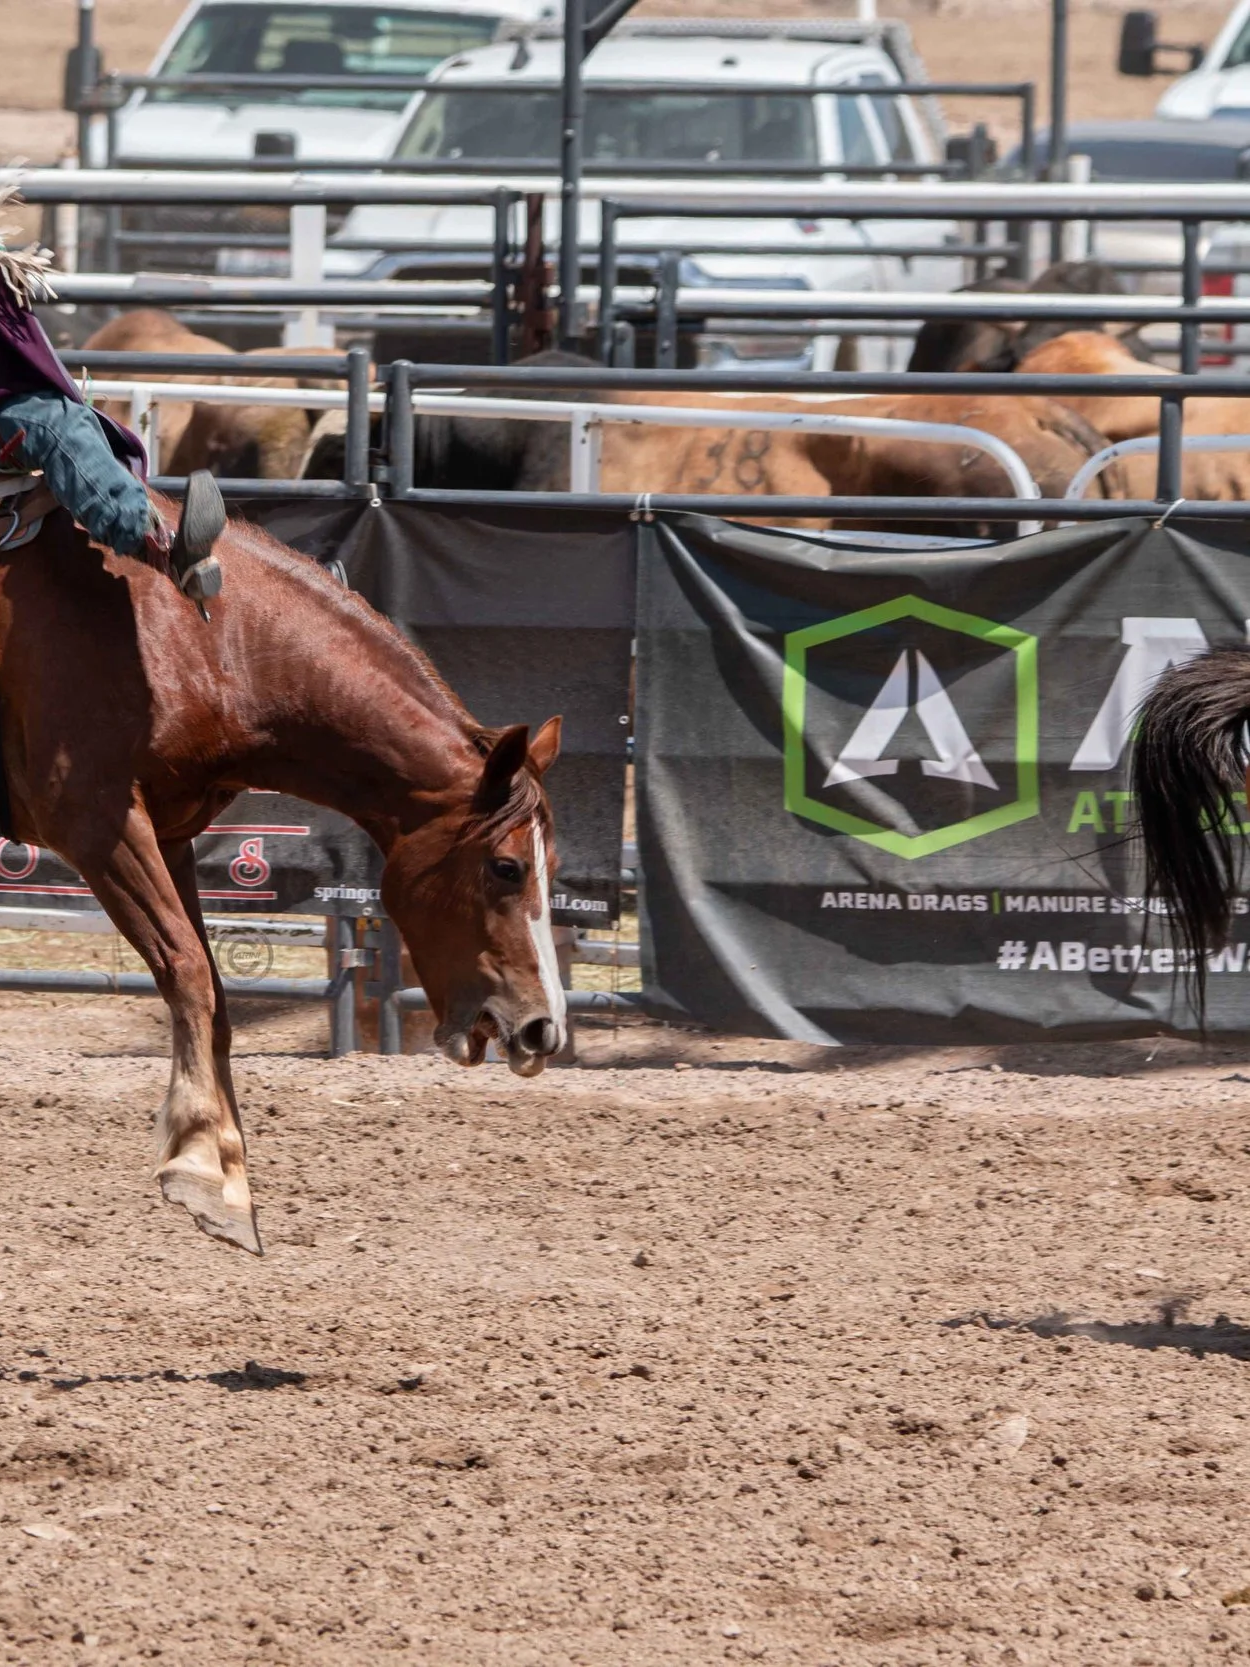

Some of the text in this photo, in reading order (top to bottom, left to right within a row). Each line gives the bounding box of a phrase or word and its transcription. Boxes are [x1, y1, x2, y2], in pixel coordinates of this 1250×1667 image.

[820, 891, 903, 910] ARENA
[907, 893, 989, 912] DRAGS
[1004, 894, 1107, 913] MANURE
